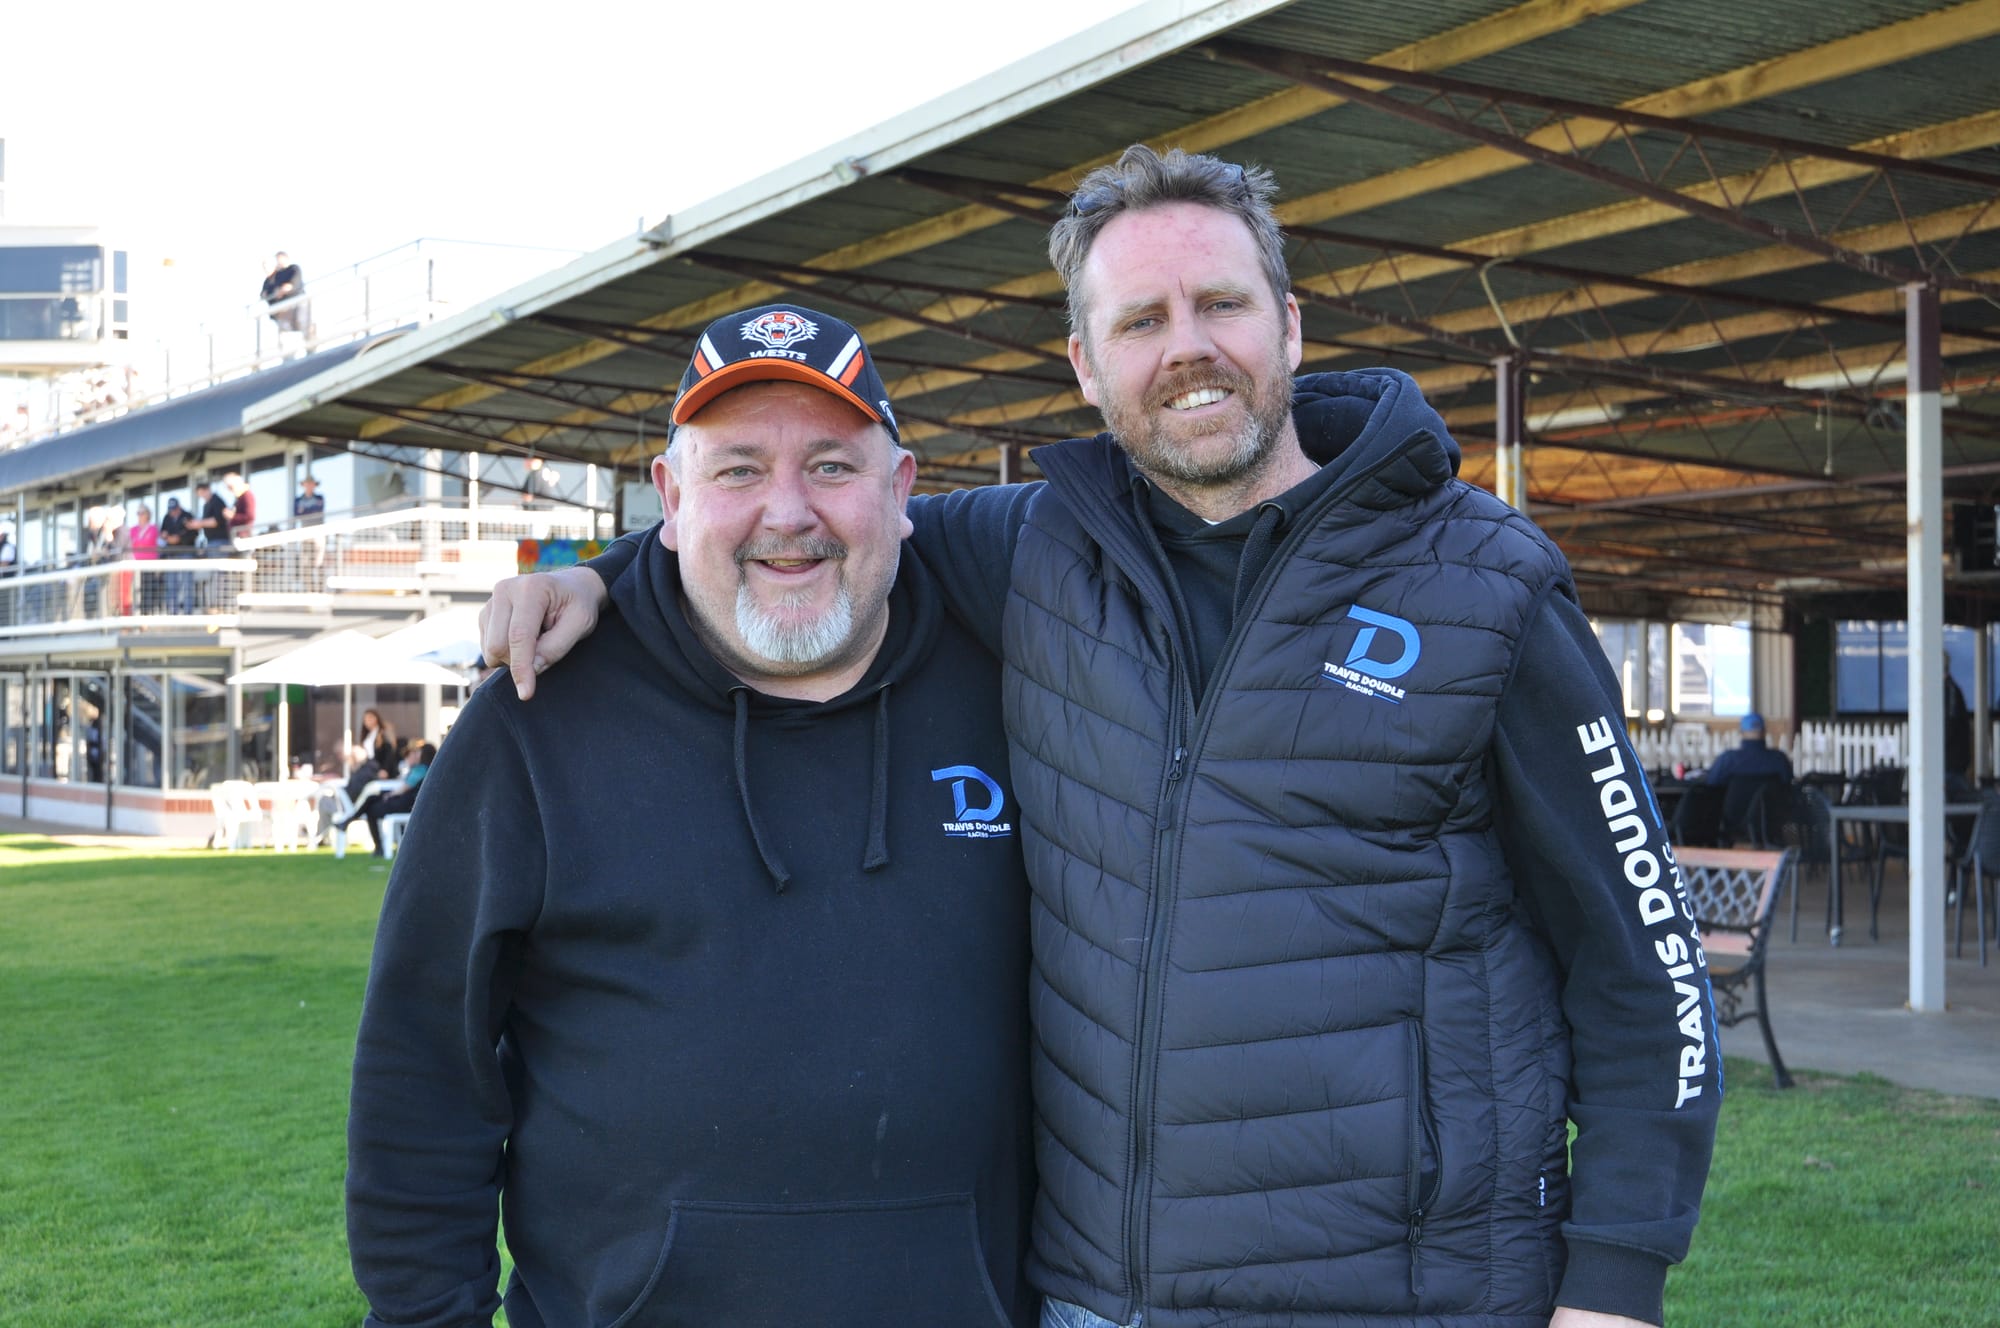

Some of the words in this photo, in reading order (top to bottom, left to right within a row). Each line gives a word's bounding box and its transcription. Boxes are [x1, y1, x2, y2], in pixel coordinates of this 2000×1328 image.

[749, 349, 807, 360] WESTS
[1324, 662, 1361, 682] TRAVIS
[1361, 675, 1405, 699] DOUDLE
[1345, 681, 1374, 696] RACING
[943, 822, 975, 832] TRAVIS
[975, 822, 1011, 832] DOUDLE
[1577, 715, 1675, 926] DOUDLE
[1655, 933, 1706, 1109] TRAVIS
